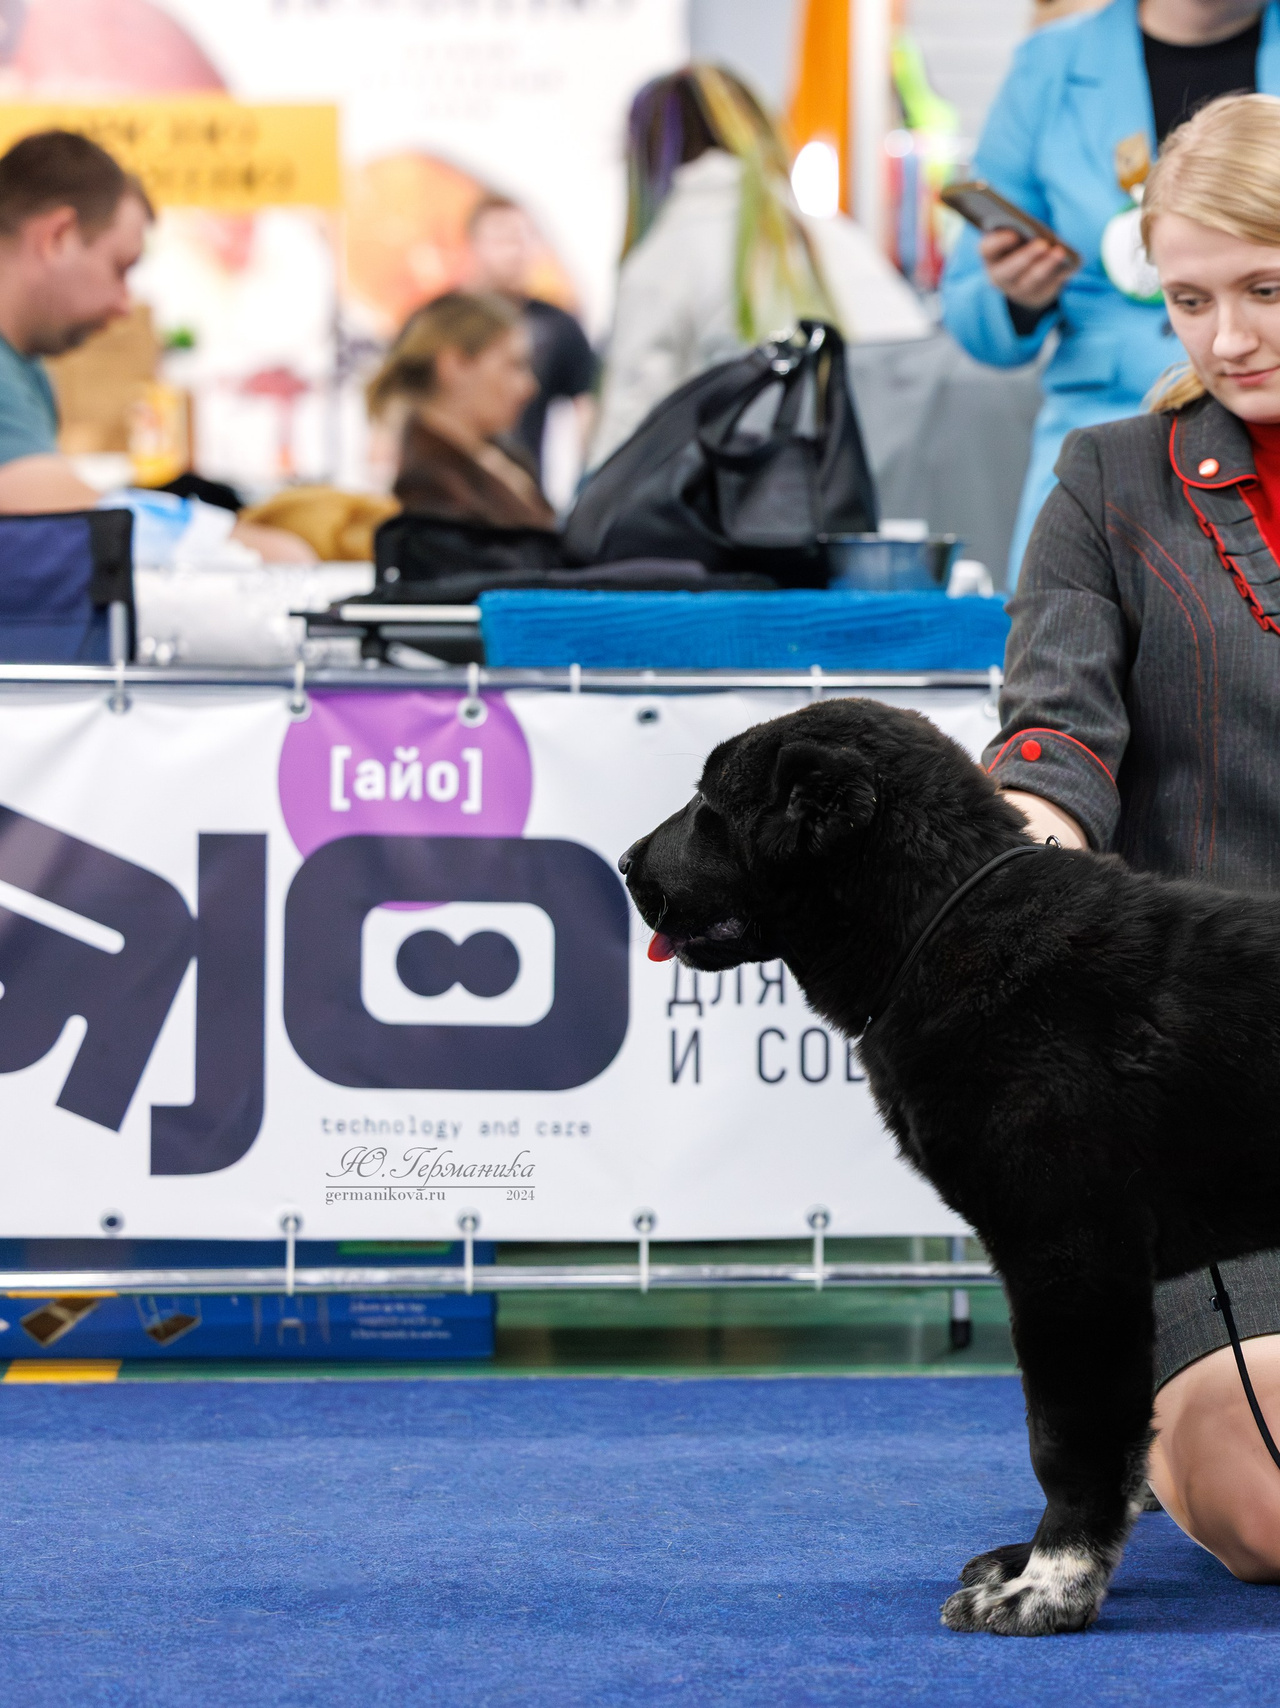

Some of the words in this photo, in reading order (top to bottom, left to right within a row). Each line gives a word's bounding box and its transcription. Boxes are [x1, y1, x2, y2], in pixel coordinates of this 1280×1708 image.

[671, 1027, 700, 1084] И
[321, 1117, 462, 1138] technology
[479, 1118, 520, 1136] and
[536, 1119, 592, 1136] care
